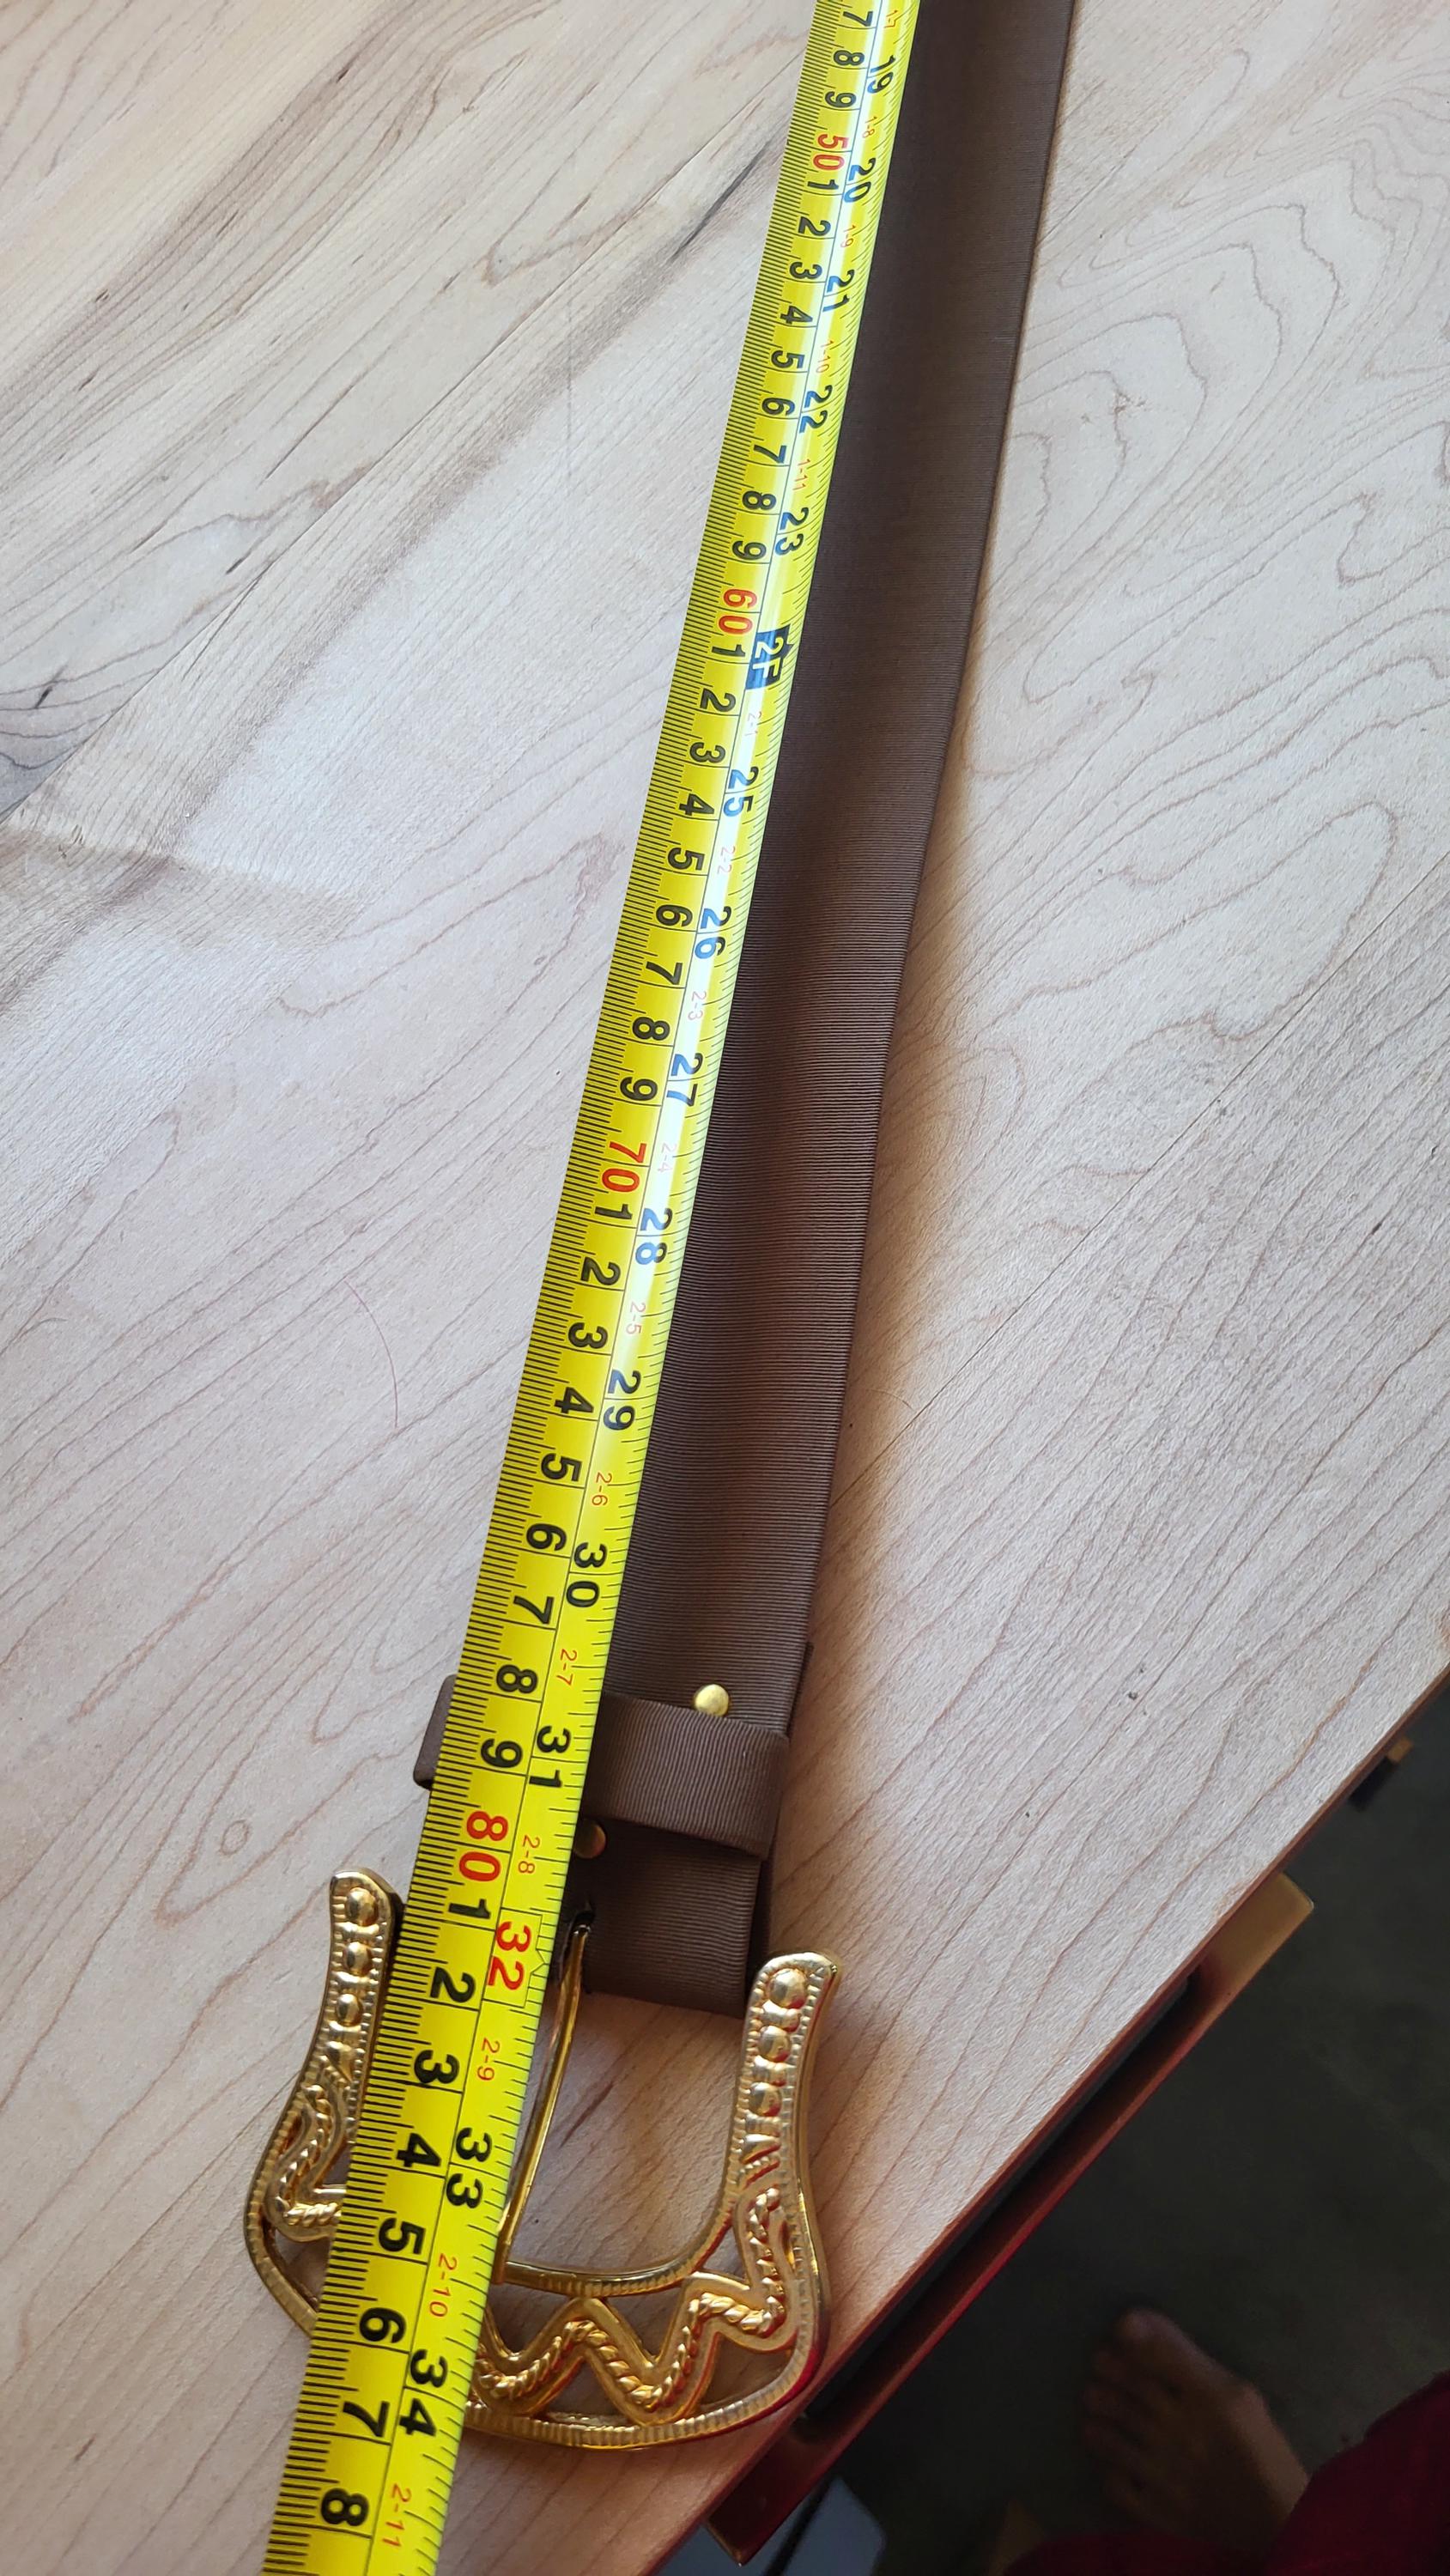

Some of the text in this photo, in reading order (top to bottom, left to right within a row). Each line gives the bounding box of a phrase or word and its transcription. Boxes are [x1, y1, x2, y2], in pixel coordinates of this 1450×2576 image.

[843, 11, 873, 27] 7
[833, 50, 865, 66] 8
[866, 55, 895, 94] 19
[825, 91, 856, 108] 9
[862, 116, 877, 138] 1-8
[813, 134, 849, 171] 50
[807, 179, 839, 190] 1
[844, 158, 876, 203] 20
[798, 216, 831, 236] 2
[840, 225, 856, 247] 1-9
[789, 262, 822, 280] 3
[822, 270, 855, 312] 21
[780, 305, 813, 325] 4
[771, 350, 805, 369] 5
[816, 340, 834, 373] 1-10
[761, 397, 795, 416] 6
[799, 385, 833, 433] 22
[754, 445, 786, 464] 7
[792, 459, 811, 490] 1-11
[742, 490, 777, 510] 8
[774, 507, 809, 556] 23
[731, 541, 767, 560] 9
[719, 589, 757, 635] 60
[712, 644, 745, 657] 1
[700, 688, 736, 713] 2
[689, 742, 725, 763] 3
[678, 793, 715, 816] 4
[723, 767, 759, 817] 25
[667, 847, 705, 871] 5
[656, 904, 693, 927] 6
[695, 906, 731, 959] 26
[646, 962, 683, 986] 7
[688, 991, 707, 1020] 2-3
[632, 1017, 670, 1041] 8
[620, 1077, 658, 1101] 9
[666, 1053, 703, 1107] 27
[602, 1141, 647, 1193] 70
[595, 1204, 632, 1220] 1
[635, 1208, 673, 1265] 28
[580, 1257, 621, 1285] 2
[626, 1302, 646, 1334] 2-5
[567, 1322, 608, 1349] 3
[555, 1388, 594, 1414] 4
[603, 1370, 641, 1431] 29
[541, 1453, 582, 1482] 5
[592, 1473, 612, 1506] 2-6
[526, 1523, 567, 1551] 6
[566, 1543, 608, 1607] 30
[513, 1595, 554, 1624] 7
[496, 1665, 537, 1693] 8
[556, 1649, 577, 1686] 2-7
[481, 1738, 523, 1768] 9
[529, 1725, 571, 1788] 31
[458, 1811, 508, 1881] 80
[518, 1835, 540, 1874] 2-8
[448, 1899, 490, 1919] 1
[488, 1921, 531, 1990] 32
[430, 1966, 476, 2002] 2
[414, 2050, 460, 2084] 3
[476, 2038, 500, 2081] 2-9
[396, 2133, 442, 2167] 4
[446, 2128, 493, 2208] 33
[378, 2218, 427, 2255] 5
[428, 2253, 458, 2318] 2-10
[359, 2307, 406, 2344] 6
[398, 2349, 447, 2438] 34
[343, 2401, 390, 2438] 7
[321, 2488, 369, 2527] 8
[382, 2482, 411, 2549] 2-11
